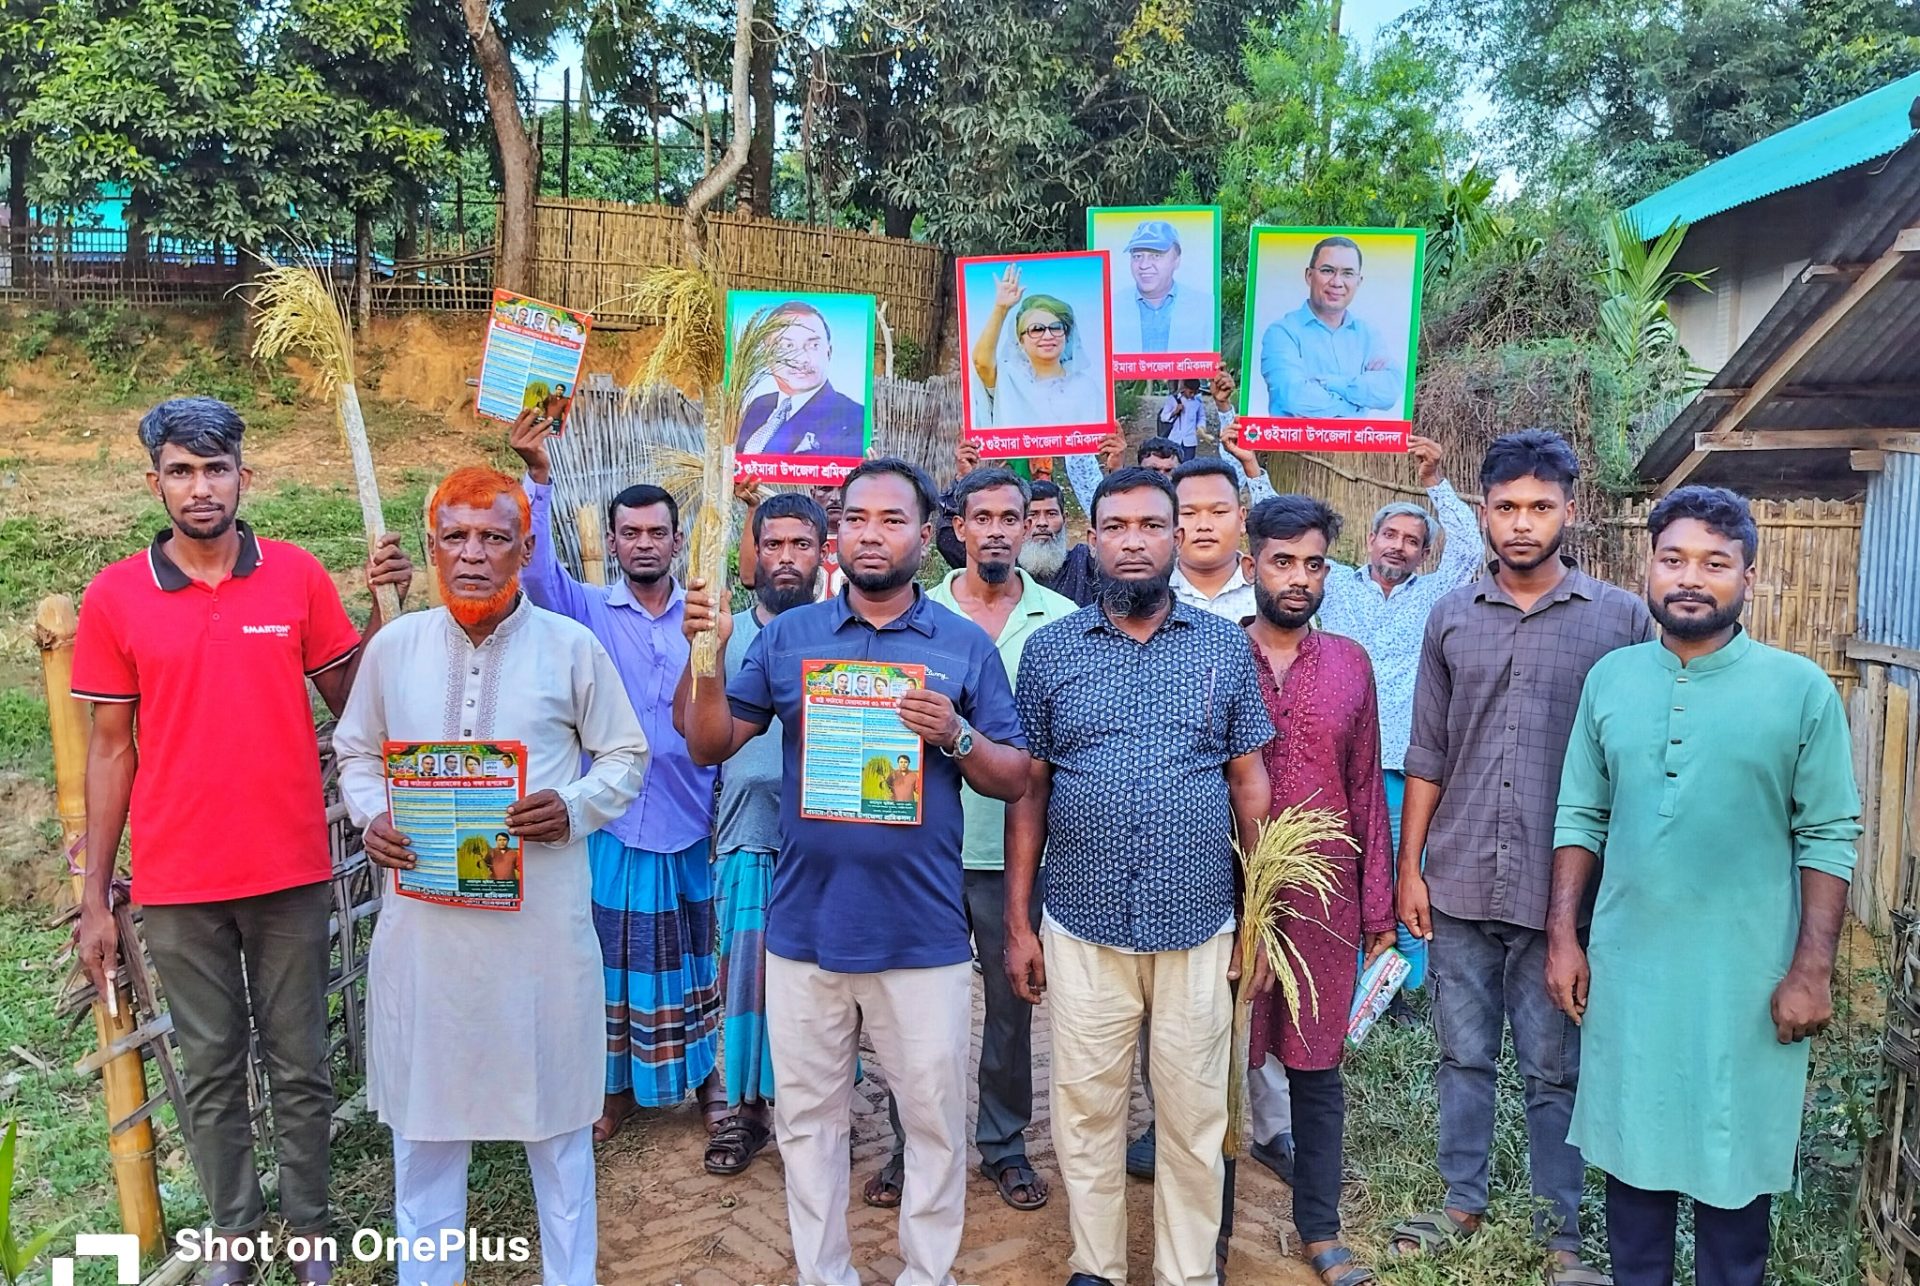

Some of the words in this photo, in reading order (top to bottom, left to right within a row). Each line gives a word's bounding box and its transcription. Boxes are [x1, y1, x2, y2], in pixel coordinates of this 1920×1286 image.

[1112, 360, 1136, 374] ইমারা
[985, 435, 1020, 451] গুইমারা
[1023, 434, 1063, 449] উপজেলা
[1263, 424, 1303, 443] গুইমারা
[1305, 423, 1352, 444] উপজেলা
[1354, 426, 1403, 445] শ্রমিকদল
[744, 461, 777, 476] গুইমারা
[779, 462, 819, 478] উপজেলা
